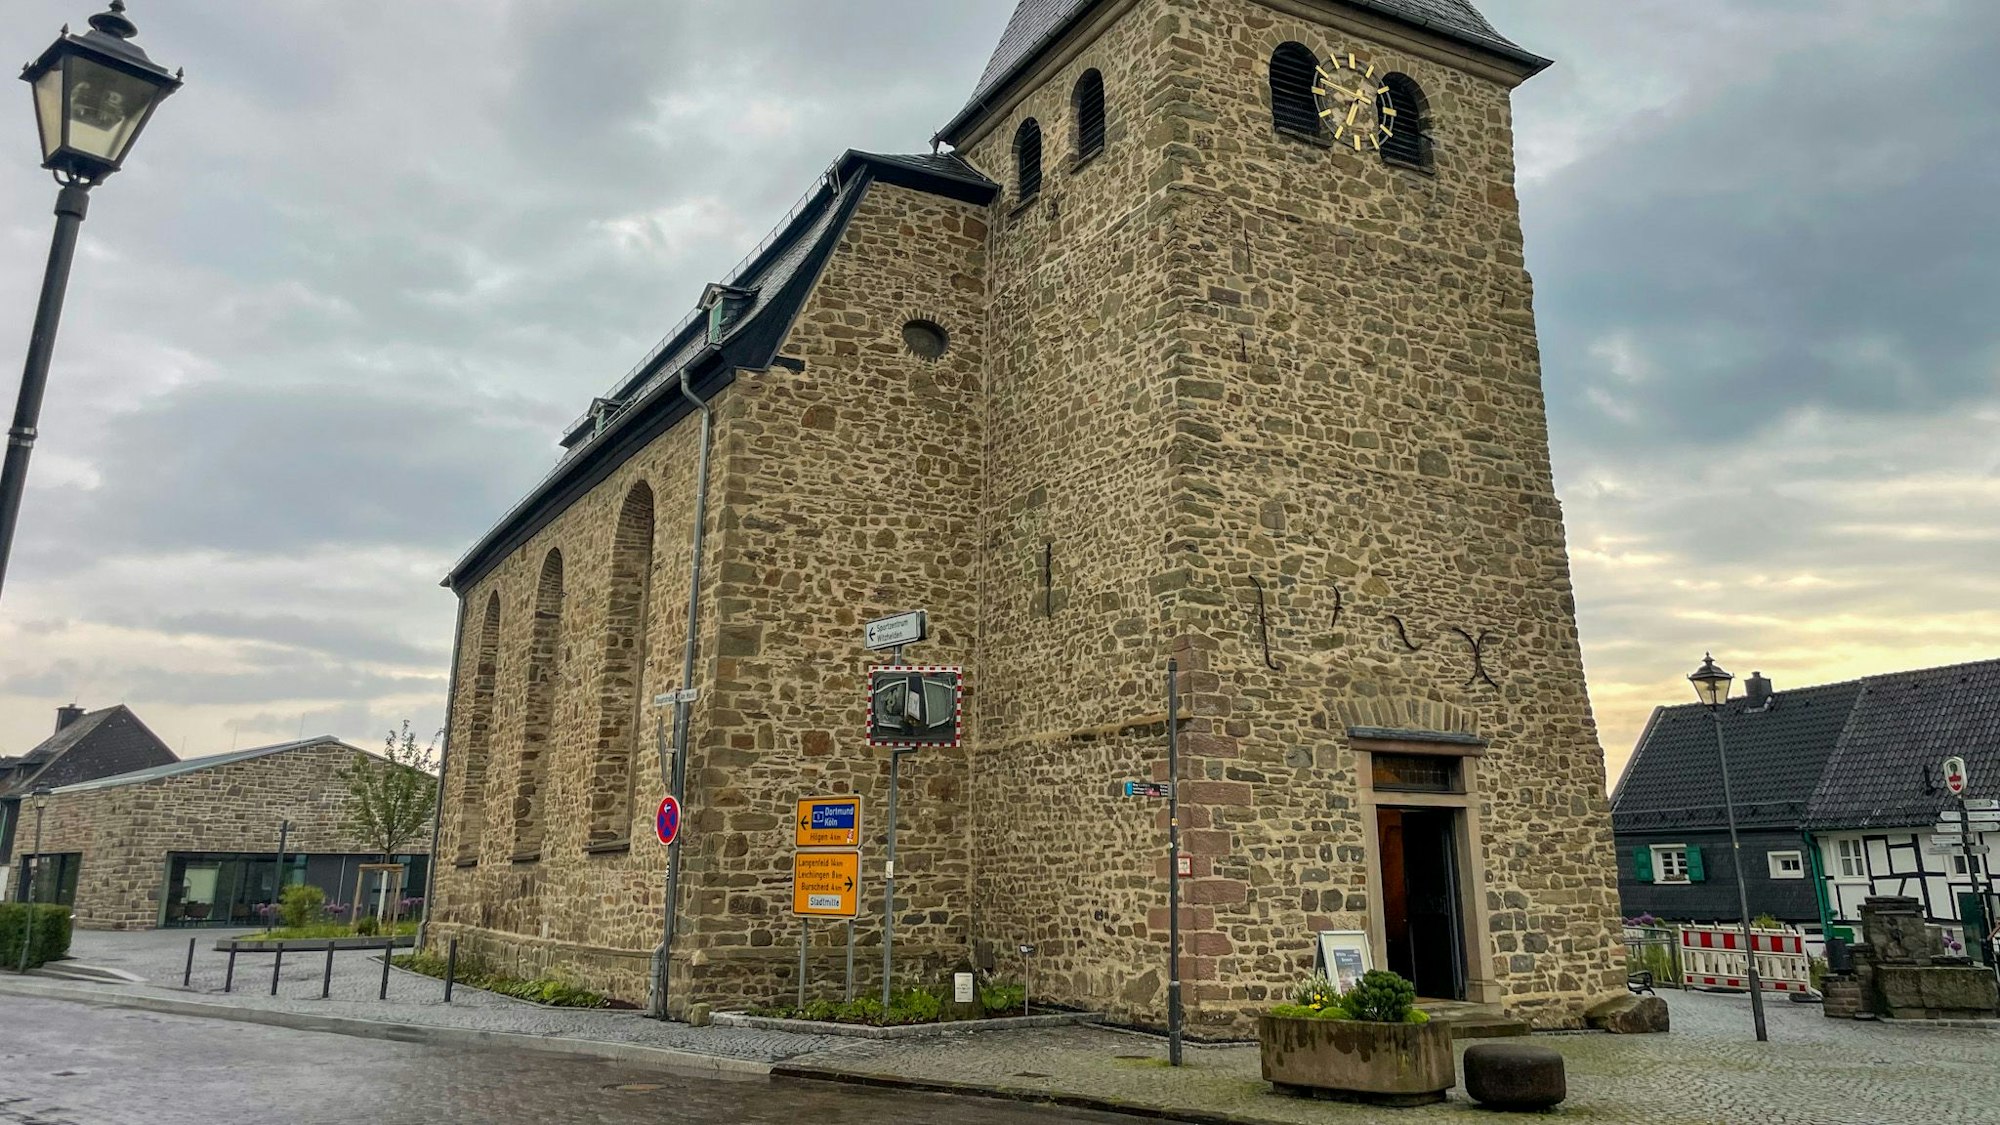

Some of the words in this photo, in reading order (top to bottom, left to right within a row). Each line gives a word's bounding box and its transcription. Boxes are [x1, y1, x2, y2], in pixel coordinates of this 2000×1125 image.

[825, 807, 854, 816] Dortmund
[824, 817, 838, 826] Köln
[798, 859, 829, 868] Langenfeld
[798, 871, 829, 880] Leichlingen
[801, 882, 829, 890] Burscheid
[810, 897, 839, 906] Stadtmitte
